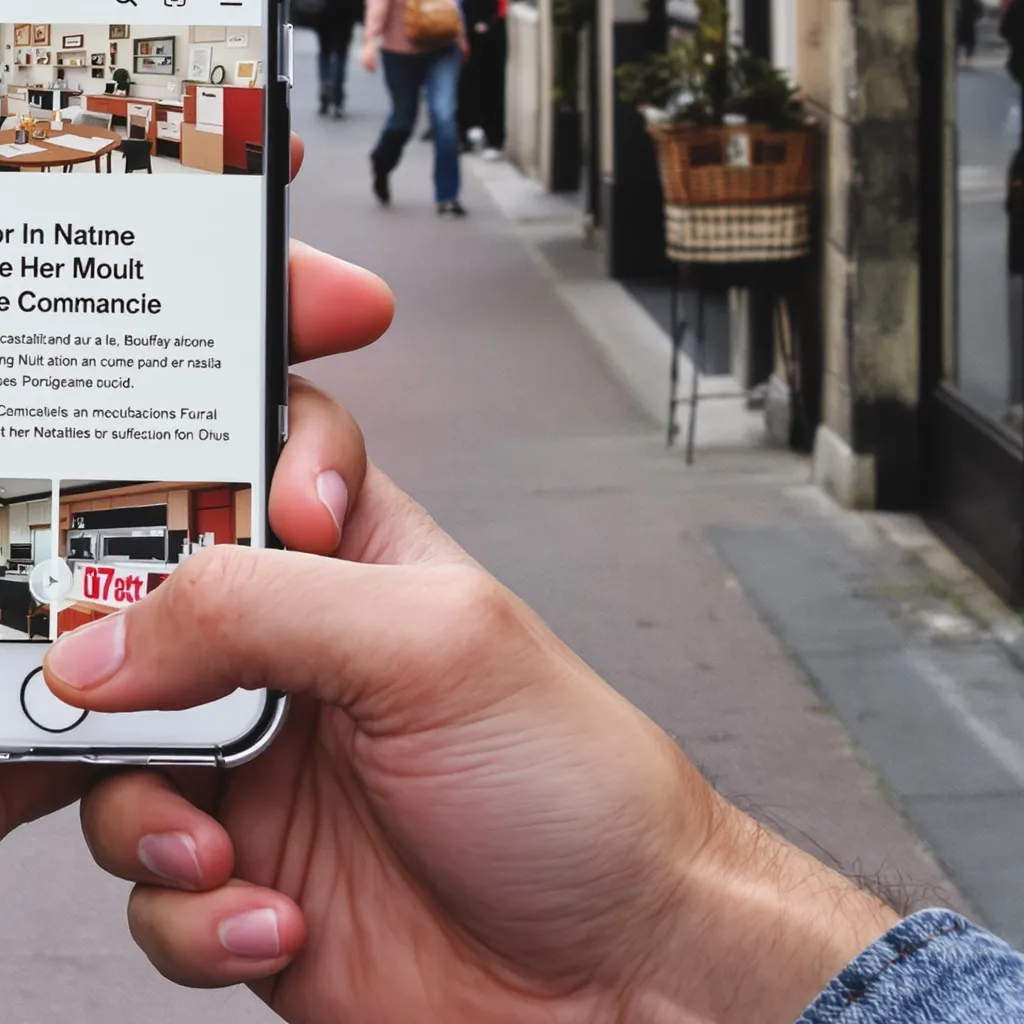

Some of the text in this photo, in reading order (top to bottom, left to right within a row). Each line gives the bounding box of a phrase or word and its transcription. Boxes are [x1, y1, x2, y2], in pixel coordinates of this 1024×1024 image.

[20, 255, 66, 280] Her
[72, 256, 145, 281] Moult
[17, 290, 163, 315] Commancie
[124, 334, 172, 350] Bouffay
[9, 425, 31, 438] her
